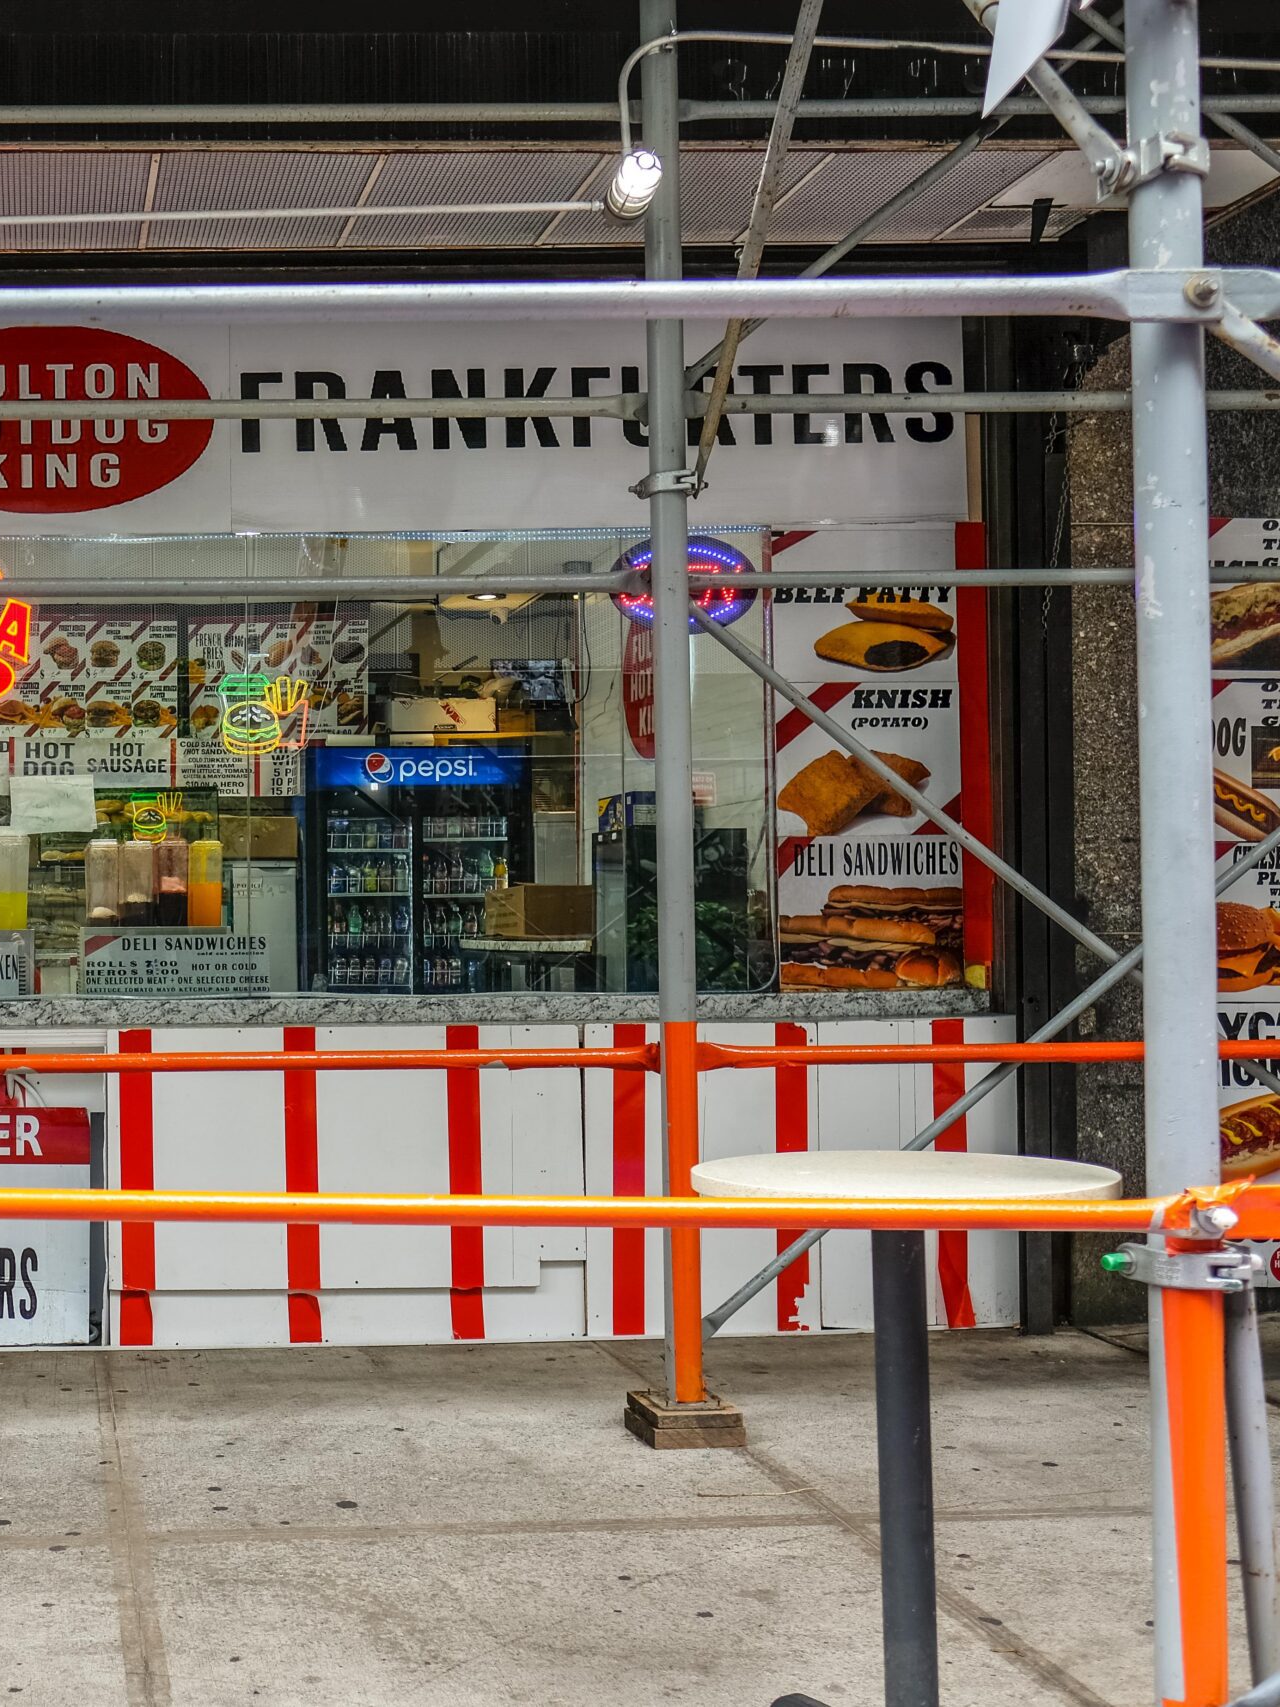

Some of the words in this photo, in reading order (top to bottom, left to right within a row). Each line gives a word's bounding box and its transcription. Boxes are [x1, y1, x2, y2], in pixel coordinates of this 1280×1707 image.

[773, 586, 850, 604] BEEF
[856, 586, 953, 604] PATTY
[195, 632, 222, 647] FRENCH
[202, 647, 224, 660] FRIES
[851, 688, 953, 709] KNISH
[850, 716, 929, 731] (POTATO)
[1212, 717, 1247, 757] OG
[25, 742, 76, 759] HOT
[109, 742, 145, 757] HOT
[23, 760, 75, 776] DOG
[86, 757, 168, 774] SAUSAGE
[399, 755, 475, 782] pepsi
[793, 843, 835, 877] DELI
[843, 841, 960, 877] SANDWICHES
[121, 937, 157, 951] DELI
[164, 936, 268, 951] SANDWICHES
[191, 963, 211, 971] HOT
[214, 963, 228, 971] OR
[231, 963, 258, 971] COLD
[85, 977, 101, 985] ONE
[104, 976, 144, 985] SELECTED
[147, 976, 167, 985] MEAT
[177, 976, 193, 985] ONE
[196, 976, 242, 984] SELECTED
[244, 975, 270, 984] CHEESE
